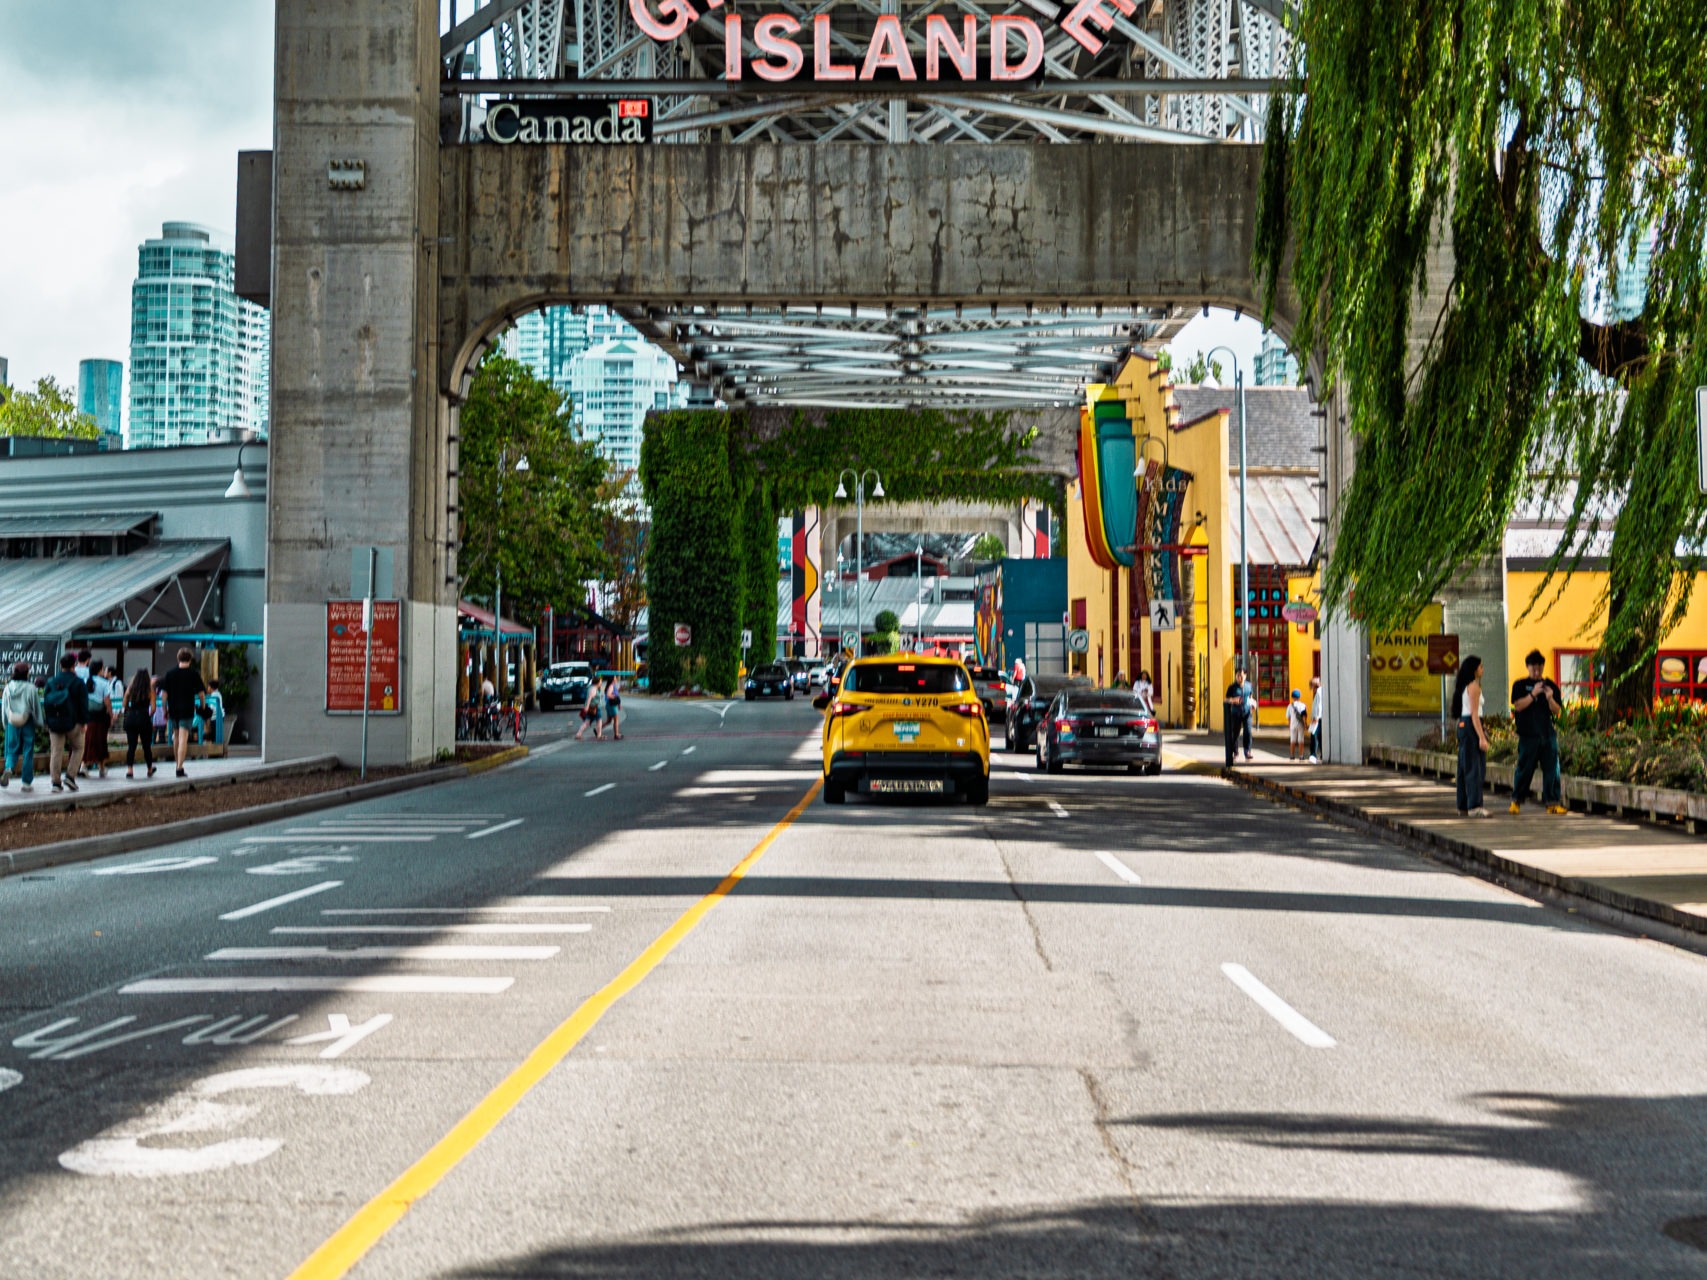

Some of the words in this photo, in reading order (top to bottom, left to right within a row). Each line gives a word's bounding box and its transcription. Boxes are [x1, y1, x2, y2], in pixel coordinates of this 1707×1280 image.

[725, 14, 1045, 82] ISLAND
[486, 103, 645, 144] Canada
[1375, 635, 1428, 646] PARKIN
[1, 650, 44, 662] NCOUVER
[915, 697, 939, 708] Y270
